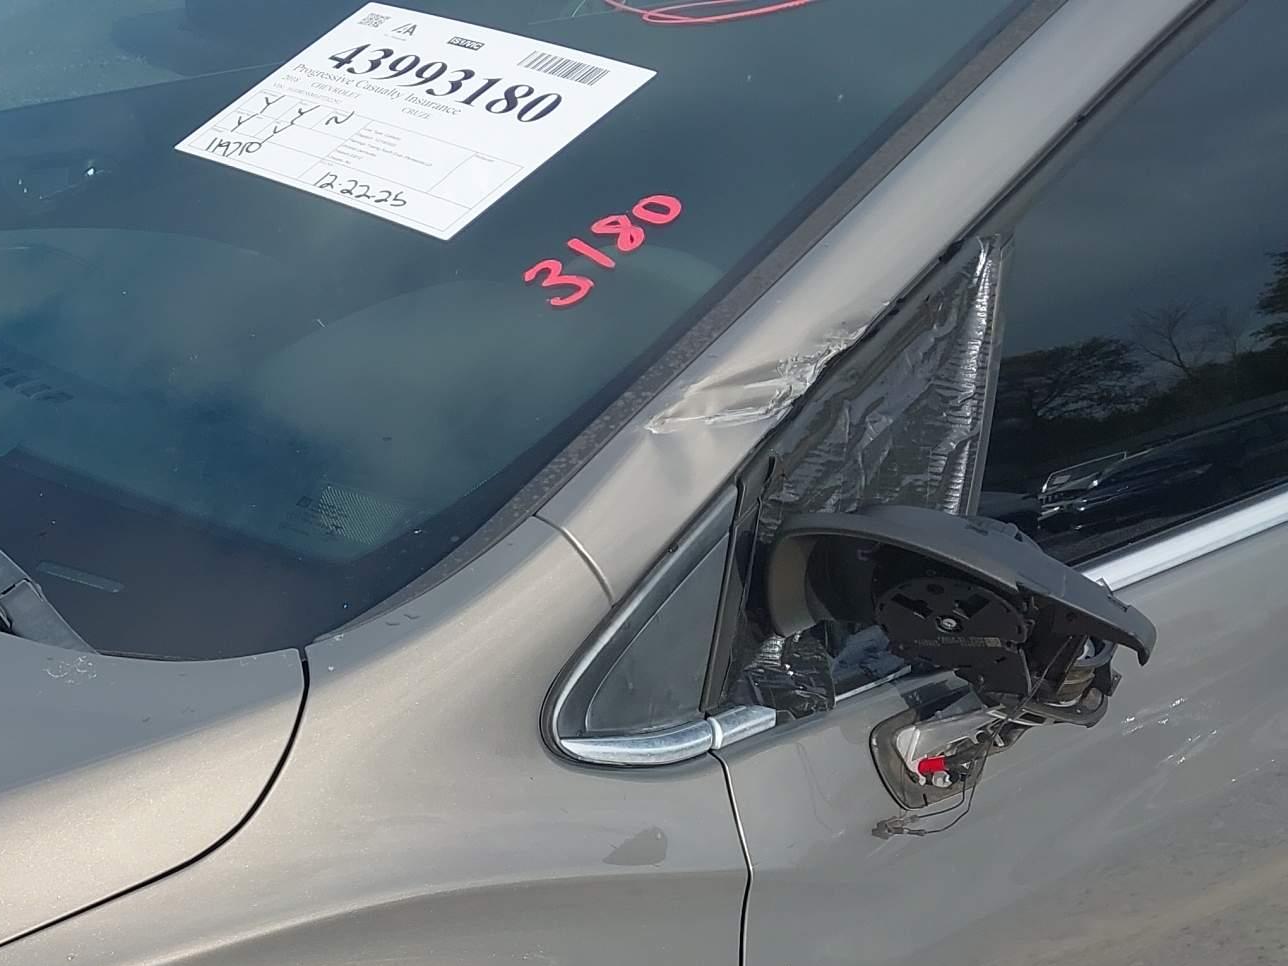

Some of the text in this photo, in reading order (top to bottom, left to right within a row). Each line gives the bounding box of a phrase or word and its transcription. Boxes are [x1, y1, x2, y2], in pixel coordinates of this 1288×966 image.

[292, 63, 355, 87] Progressive
[355, 78, 402, 100] Casualty
[404, 92, 462, 116] Insurance
[311, 80, 362, 100] CHEVROLET
[327, 43, 562, 123] 43993180
[523, 194, 682, 306] 3180
